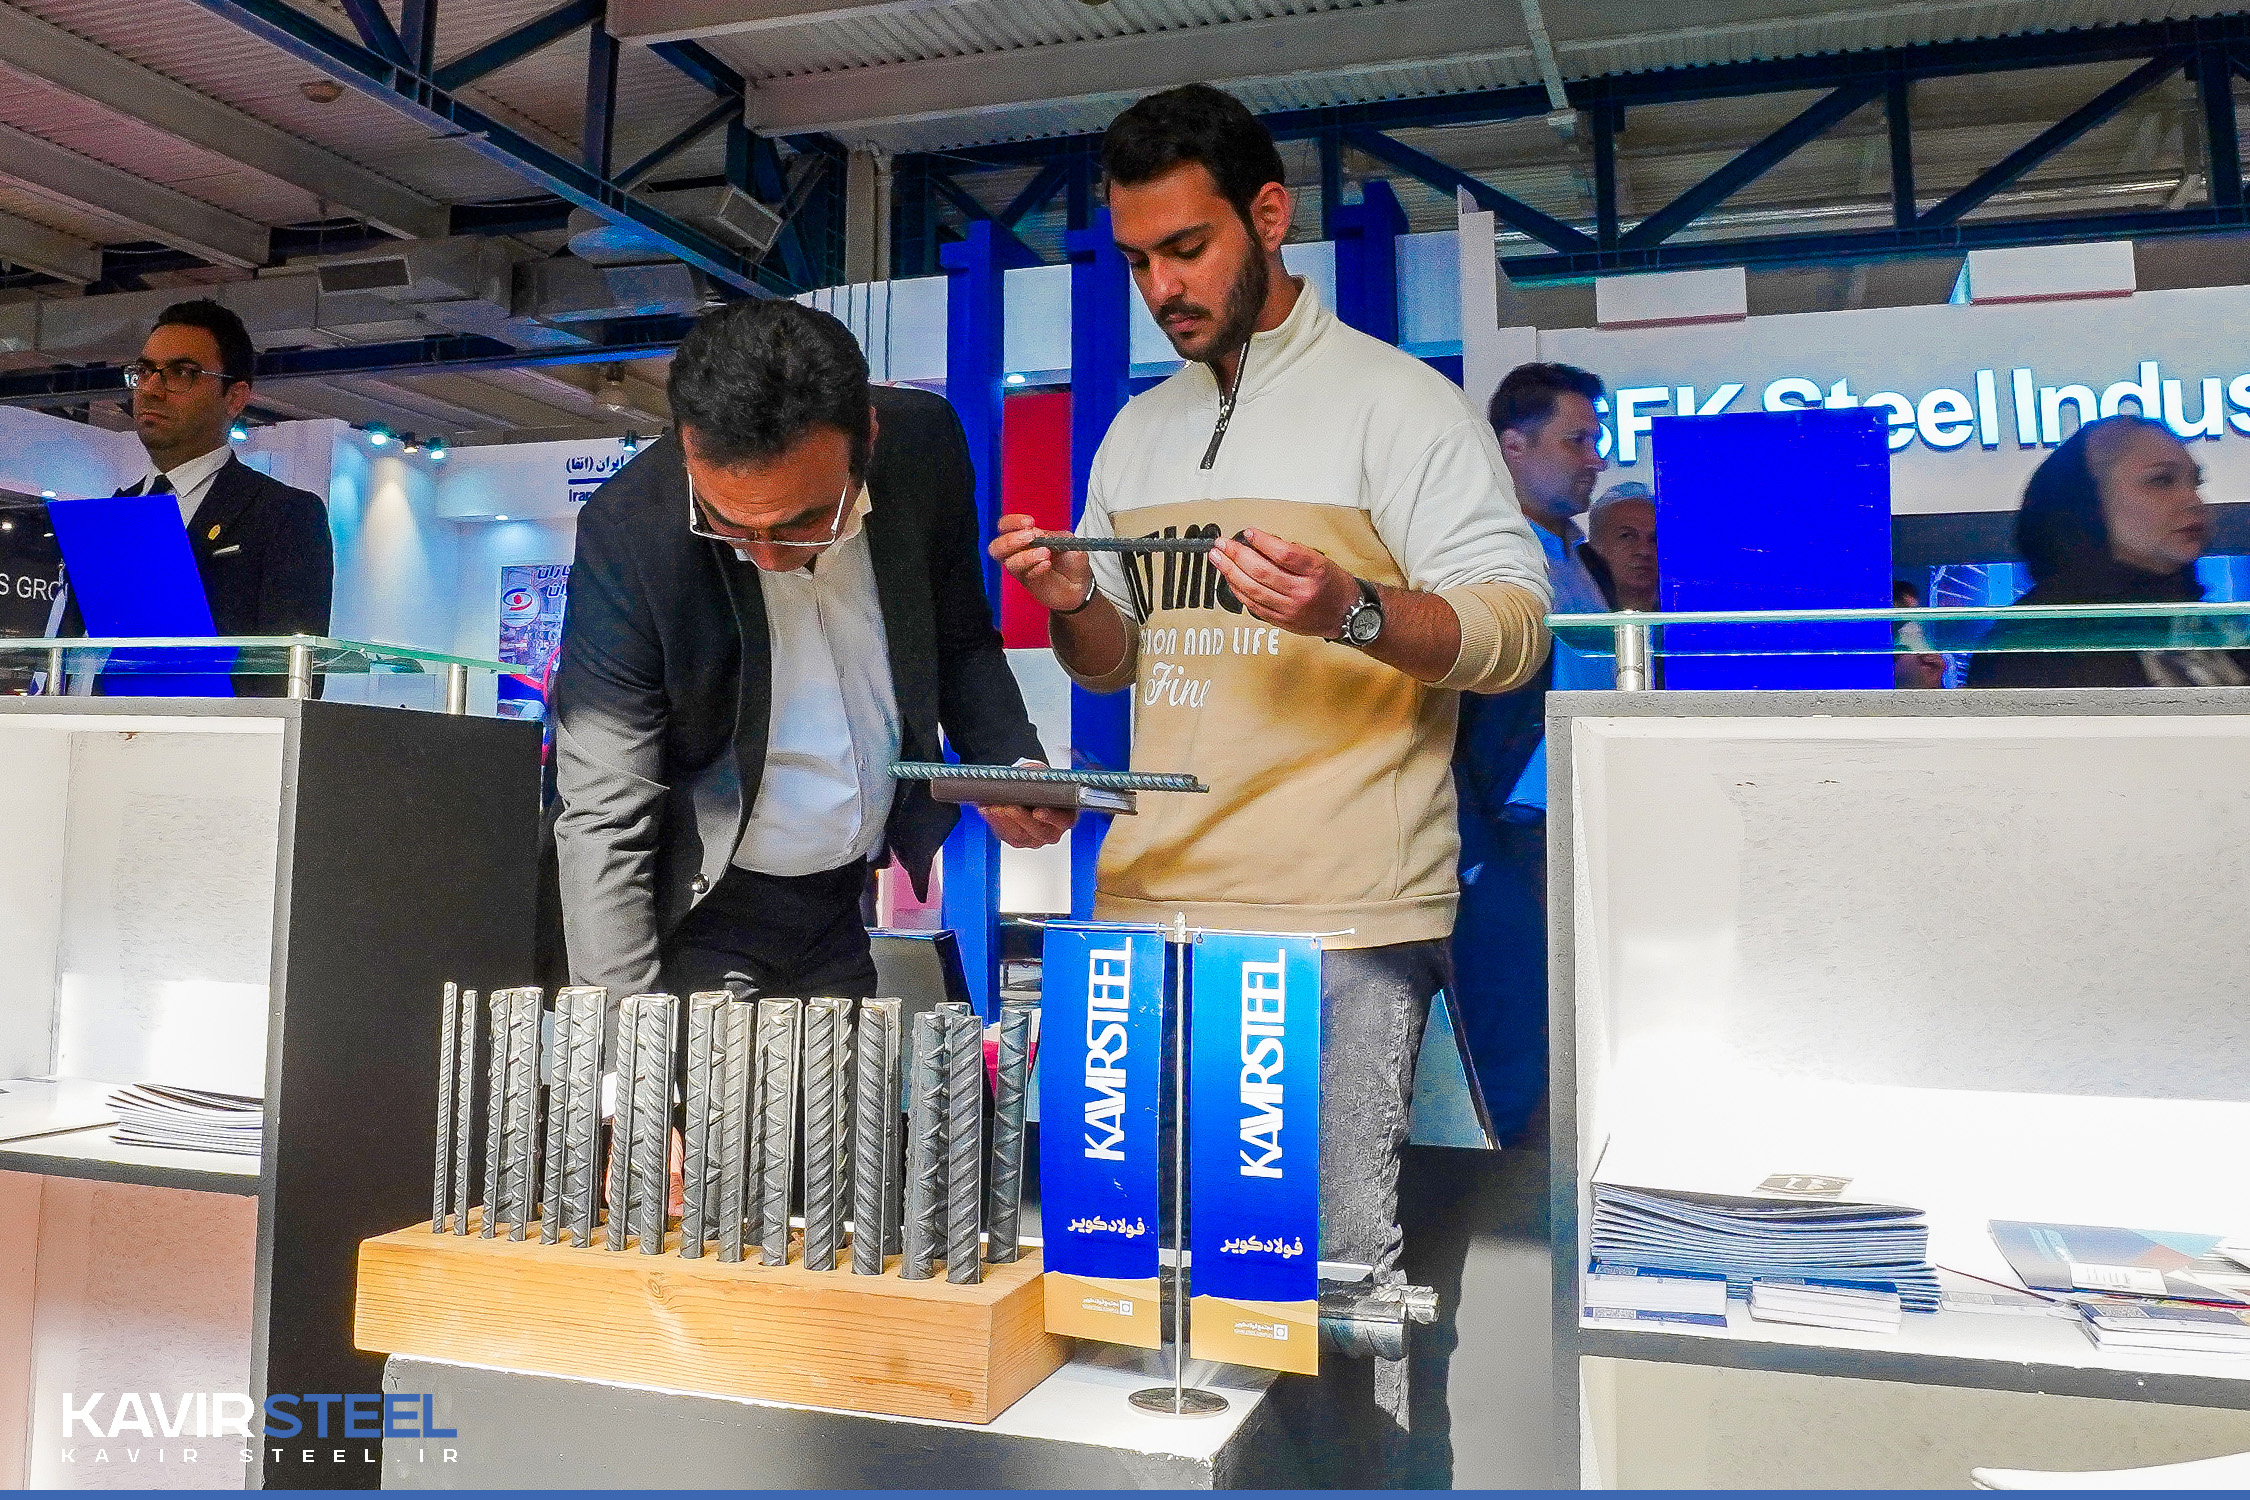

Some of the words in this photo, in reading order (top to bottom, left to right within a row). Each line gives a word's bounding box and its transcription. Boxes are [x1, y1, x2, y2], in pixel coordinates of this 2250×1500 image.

[17, 576, 69, 602] GRO
[1183, 627, 1225, 656] AND
[1232, 627, 1281, 655] LIFE
